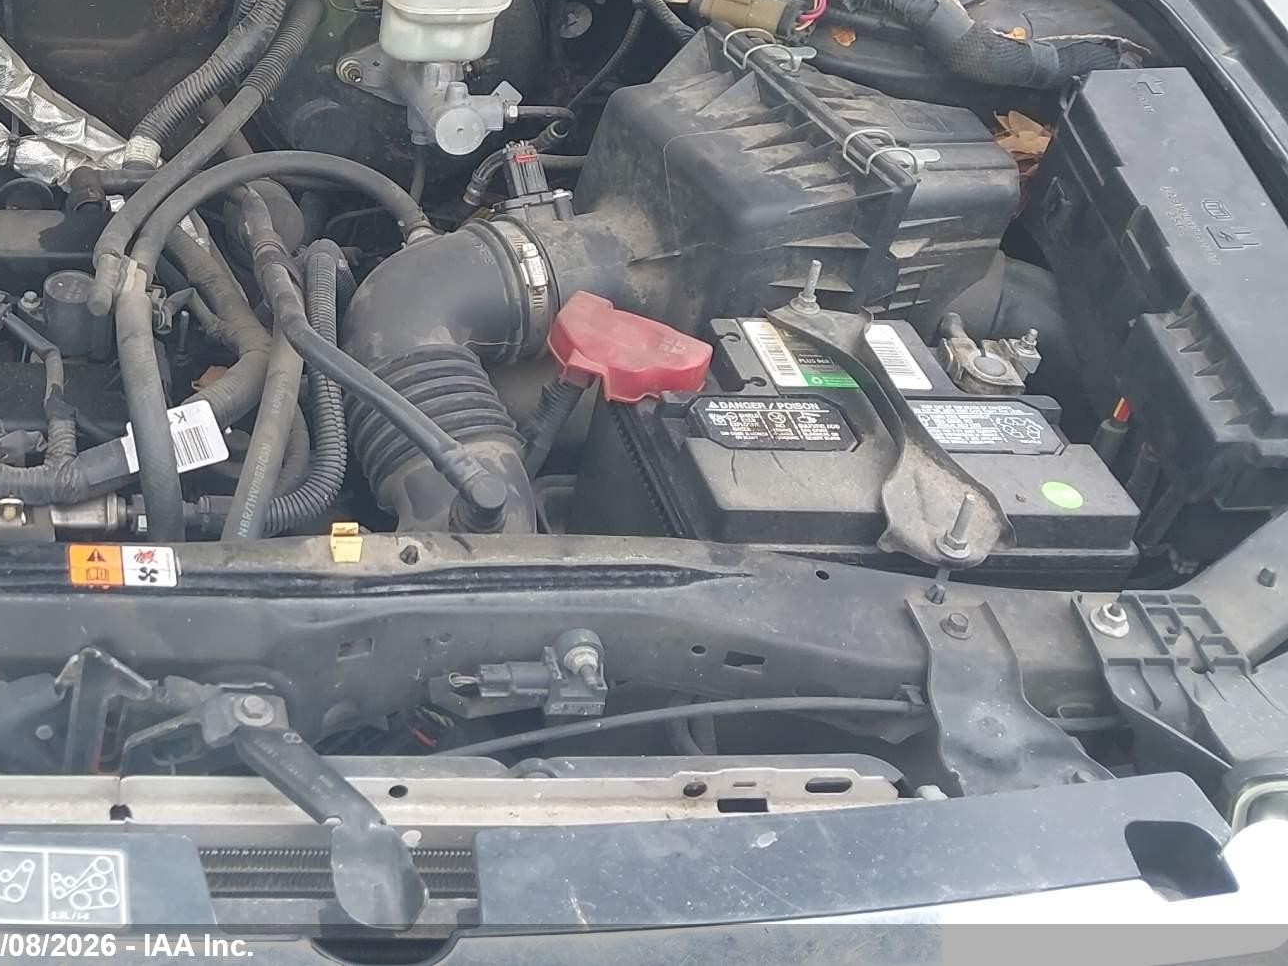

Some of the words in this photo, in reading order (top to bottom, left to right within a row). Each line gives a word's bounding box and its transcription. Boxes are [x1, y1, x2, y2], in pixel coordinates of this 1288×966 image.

[718, 402, 766, 410] DANGER
[768, 402, 775, 411] /
[778, 402, 820, 411] POISON
